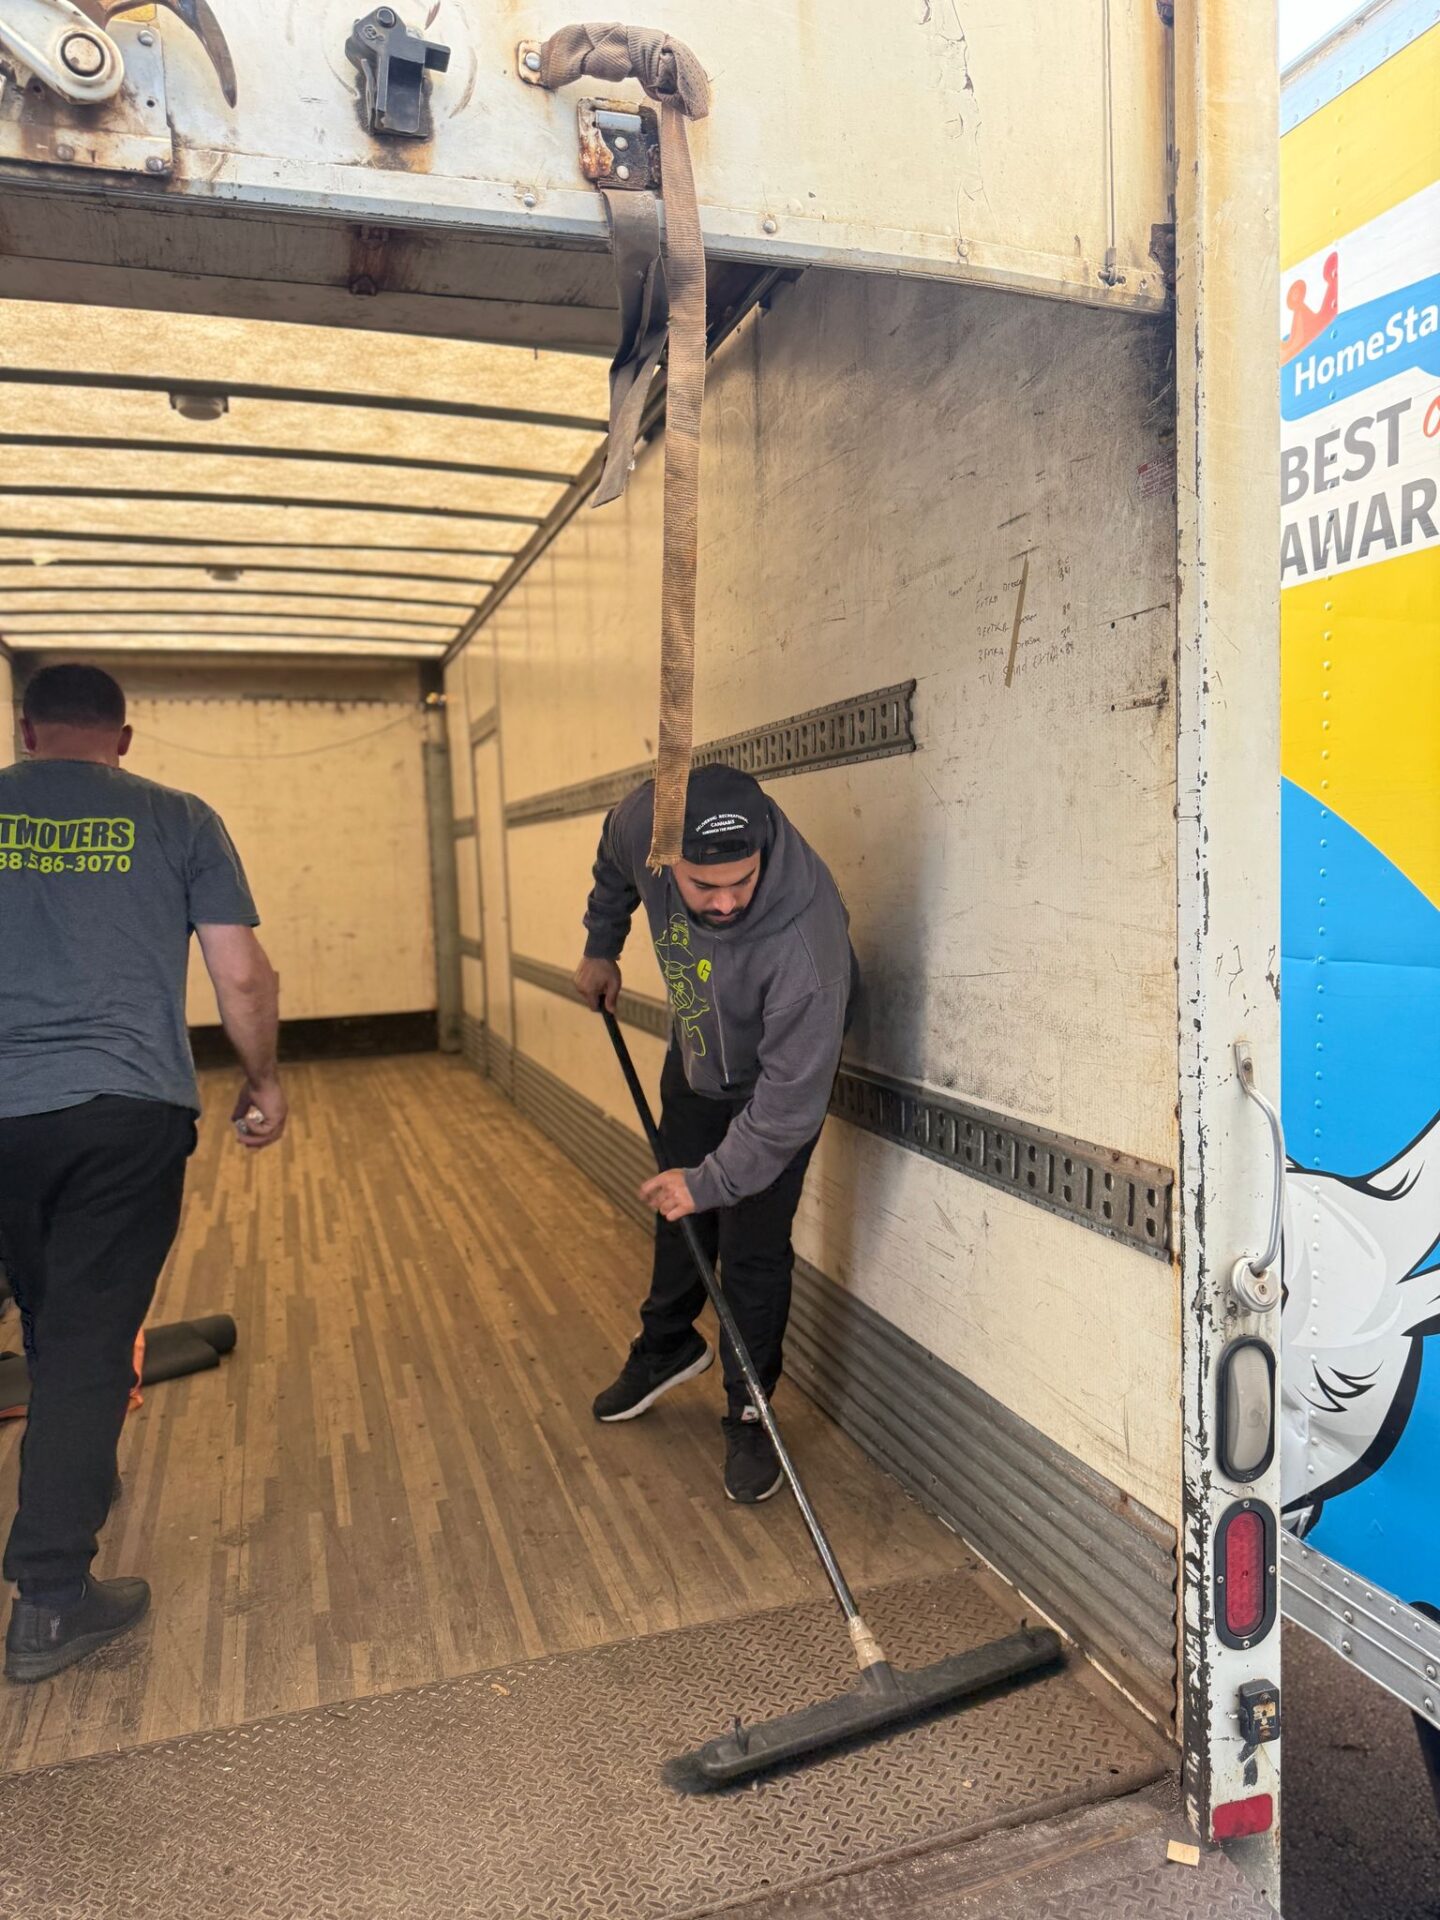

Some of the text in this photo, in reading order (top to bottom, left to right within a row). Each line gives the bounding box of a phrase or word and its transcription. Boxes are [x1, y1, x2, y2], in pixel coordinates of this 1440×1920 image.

[1294, 304, 1439, 396] HomeSta
[1281, 397, 1412, 506] BEST
[1280, 478, 1440, 581] AWAR
